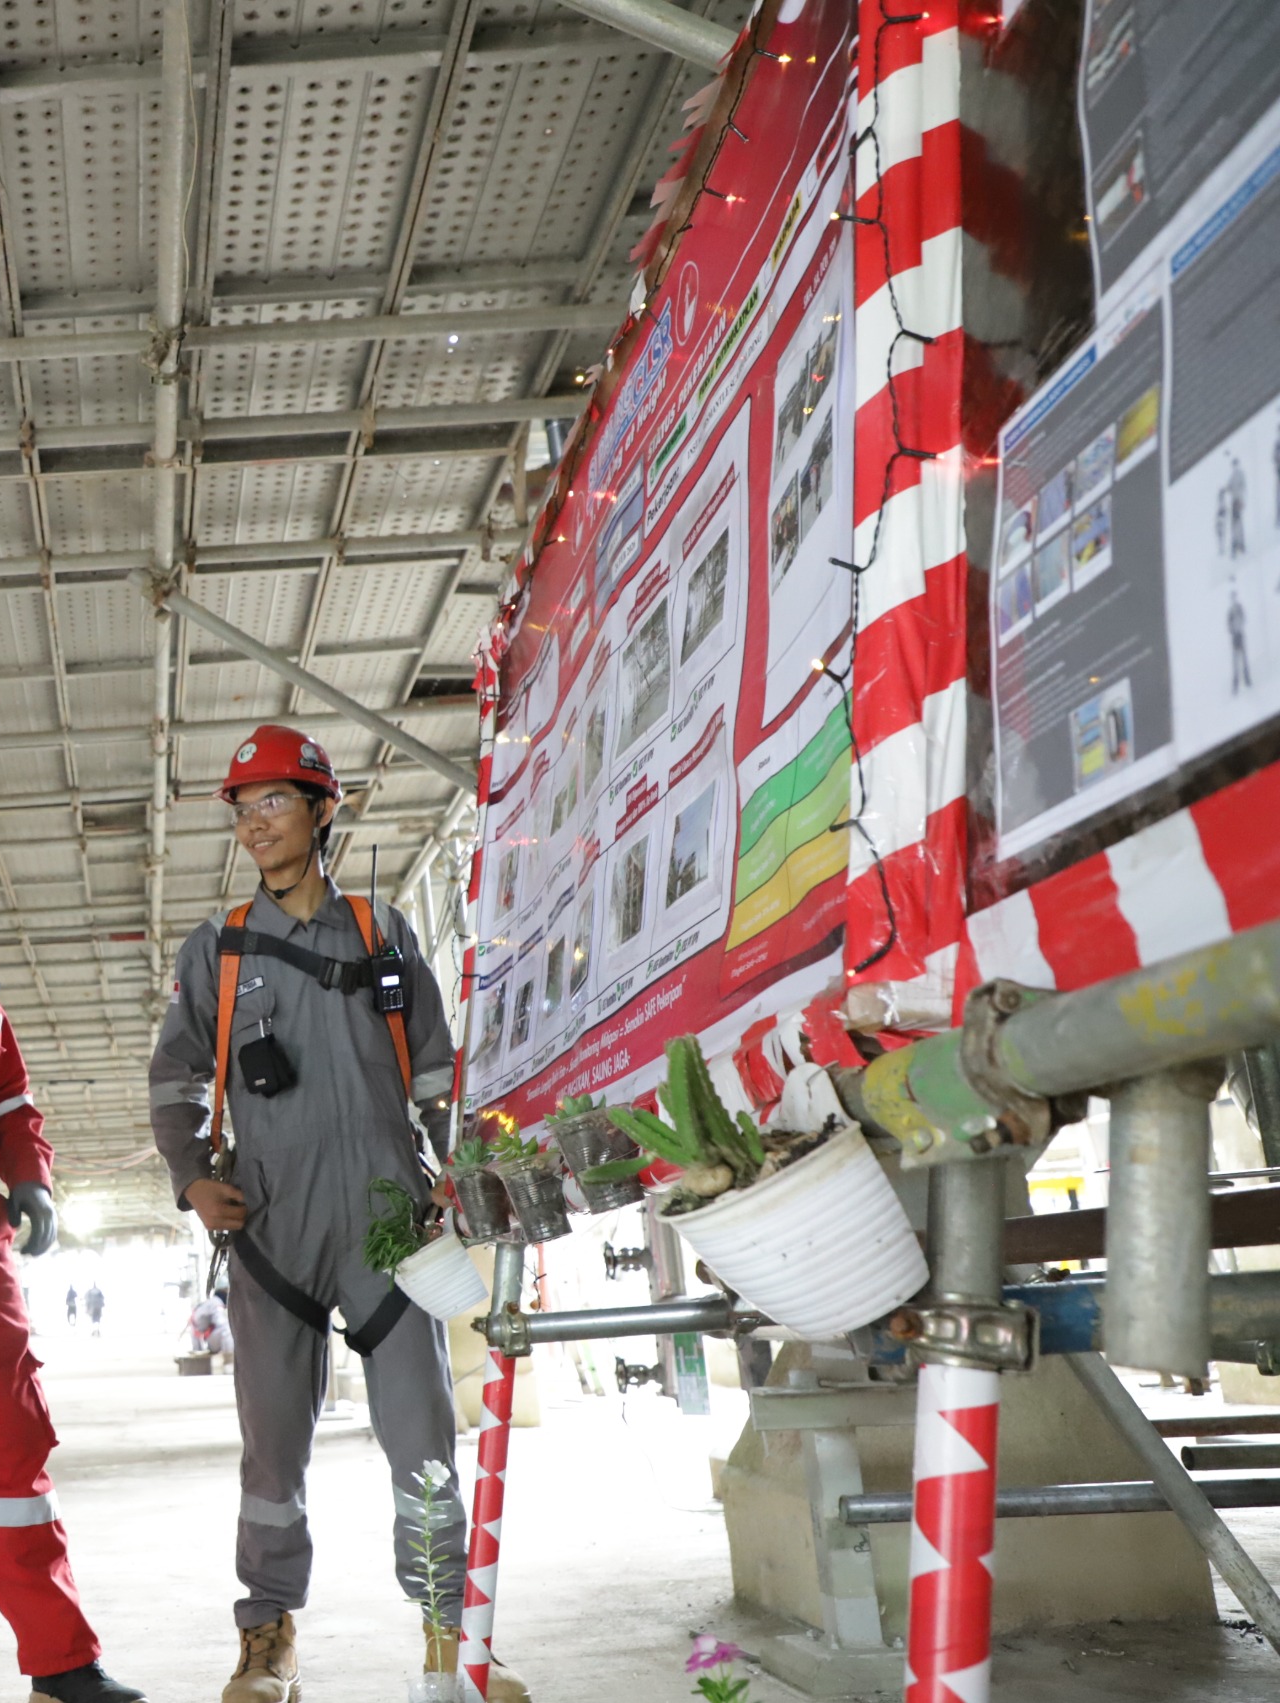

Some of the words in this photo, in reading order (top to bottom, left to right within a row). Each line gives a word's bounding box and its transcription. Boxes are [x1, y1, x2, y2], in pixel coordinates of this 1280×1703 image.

[634, 311, 672, 404] CLSR
[648, 403, 676, 461] STATUS
[678, 310, 727, 412] PEKERJAAN
[626, 424, 635, 451] at
[637, 367, 667, 432] Height
[644, 997, 657, 1021] SAFE
[592, 1057, 613, 1085] SALING
